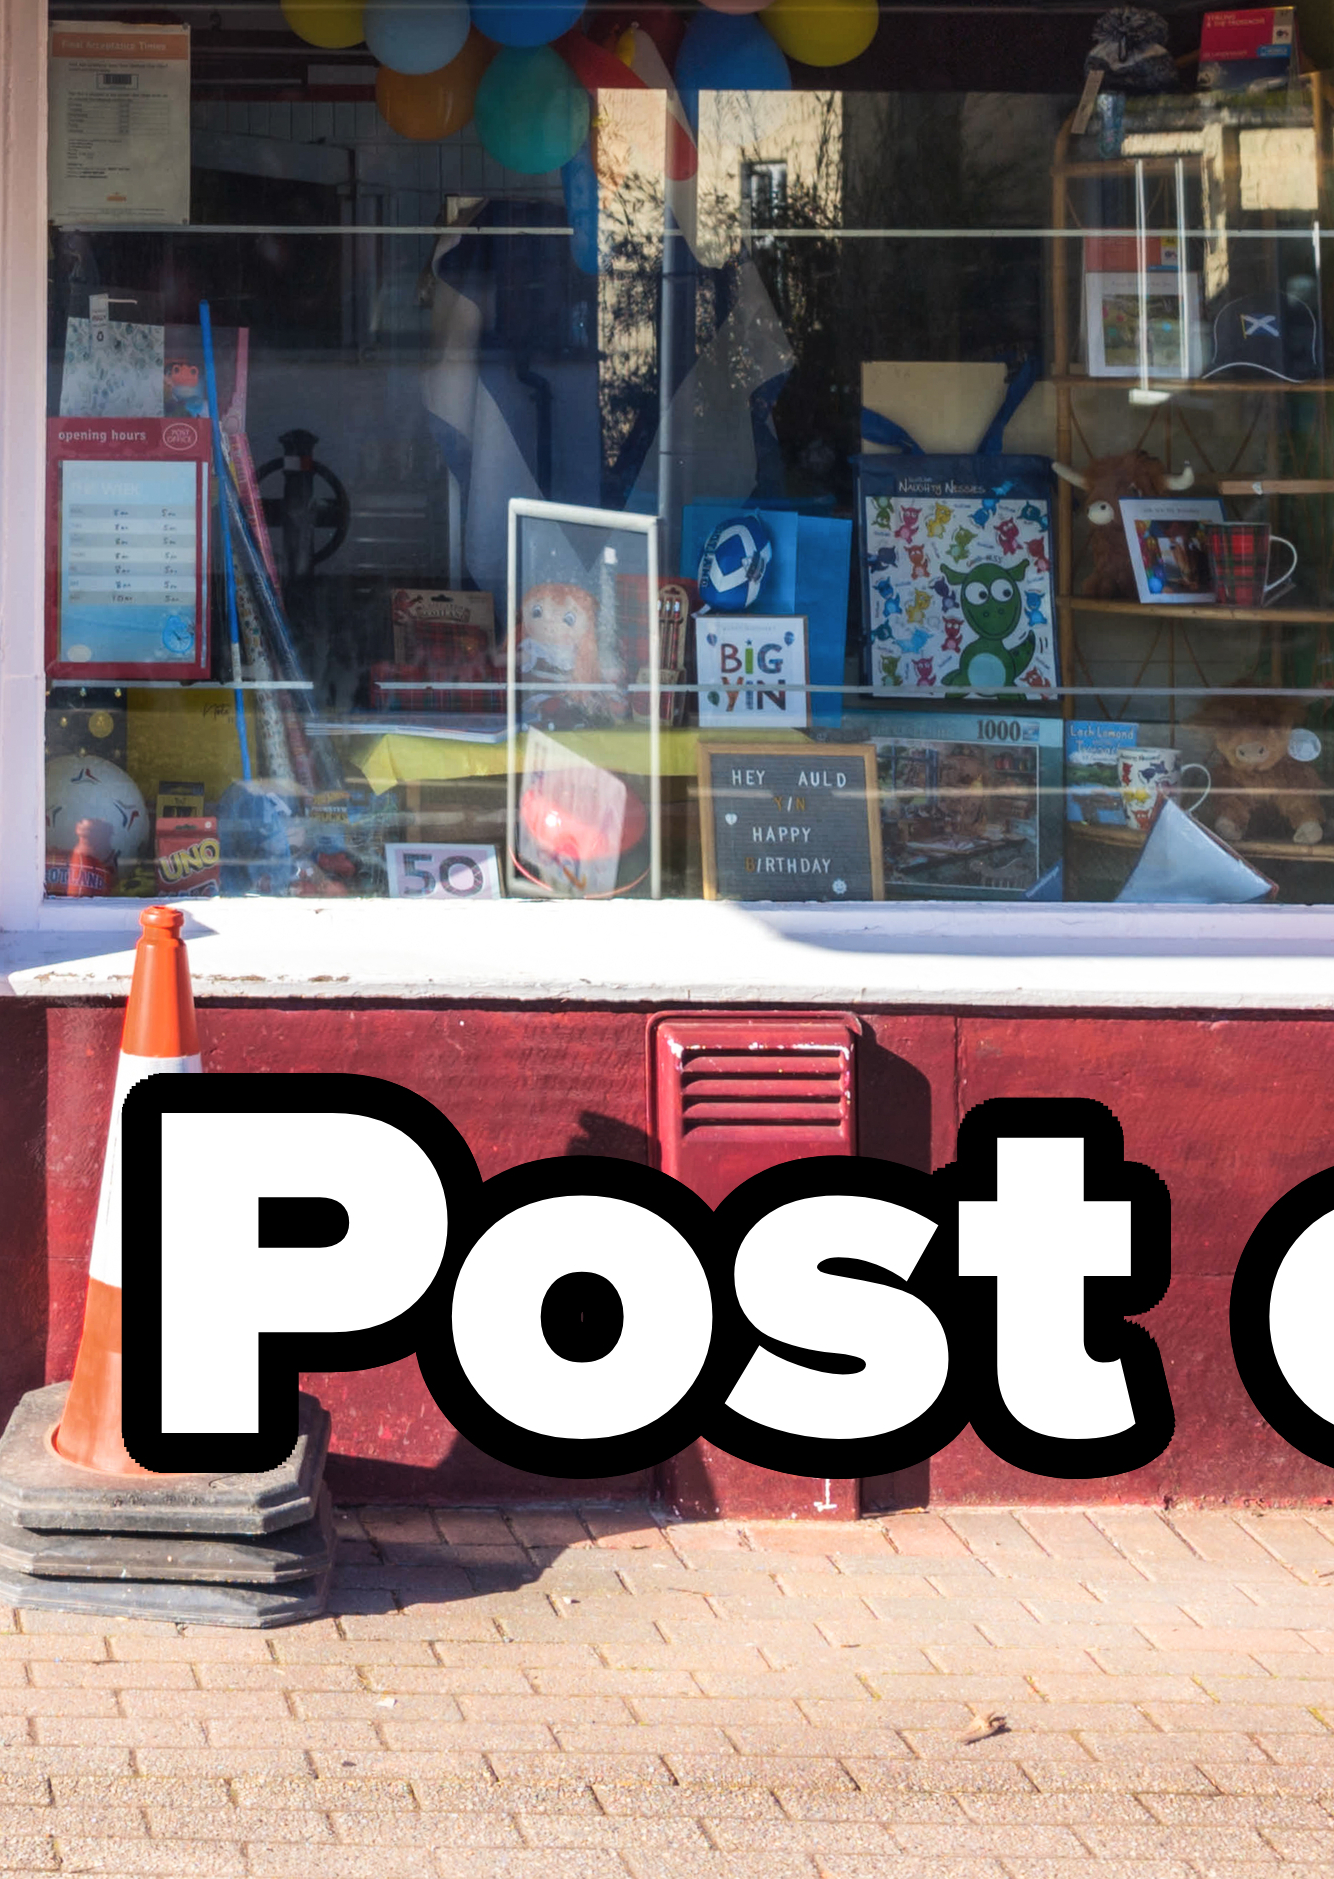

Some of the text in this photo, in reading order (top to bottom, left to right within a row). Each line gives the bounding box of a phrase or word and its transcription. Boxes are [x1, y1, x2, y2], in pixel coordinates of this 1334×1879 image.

[85, 40, 136, 51] Acceptance
[58, 429, 147, 443] opening hours
[167, 435, 192, 444] OFFICE
[171, 428, 190, 436] POST
[977, 719, 1021, 742] 1000
[731, 769, 847, 788] HEY AULD
[752, 826, 812, 843] HAPPY
[160, 838, 220, 884] UNO
[402, 853, 485, 898] 50
